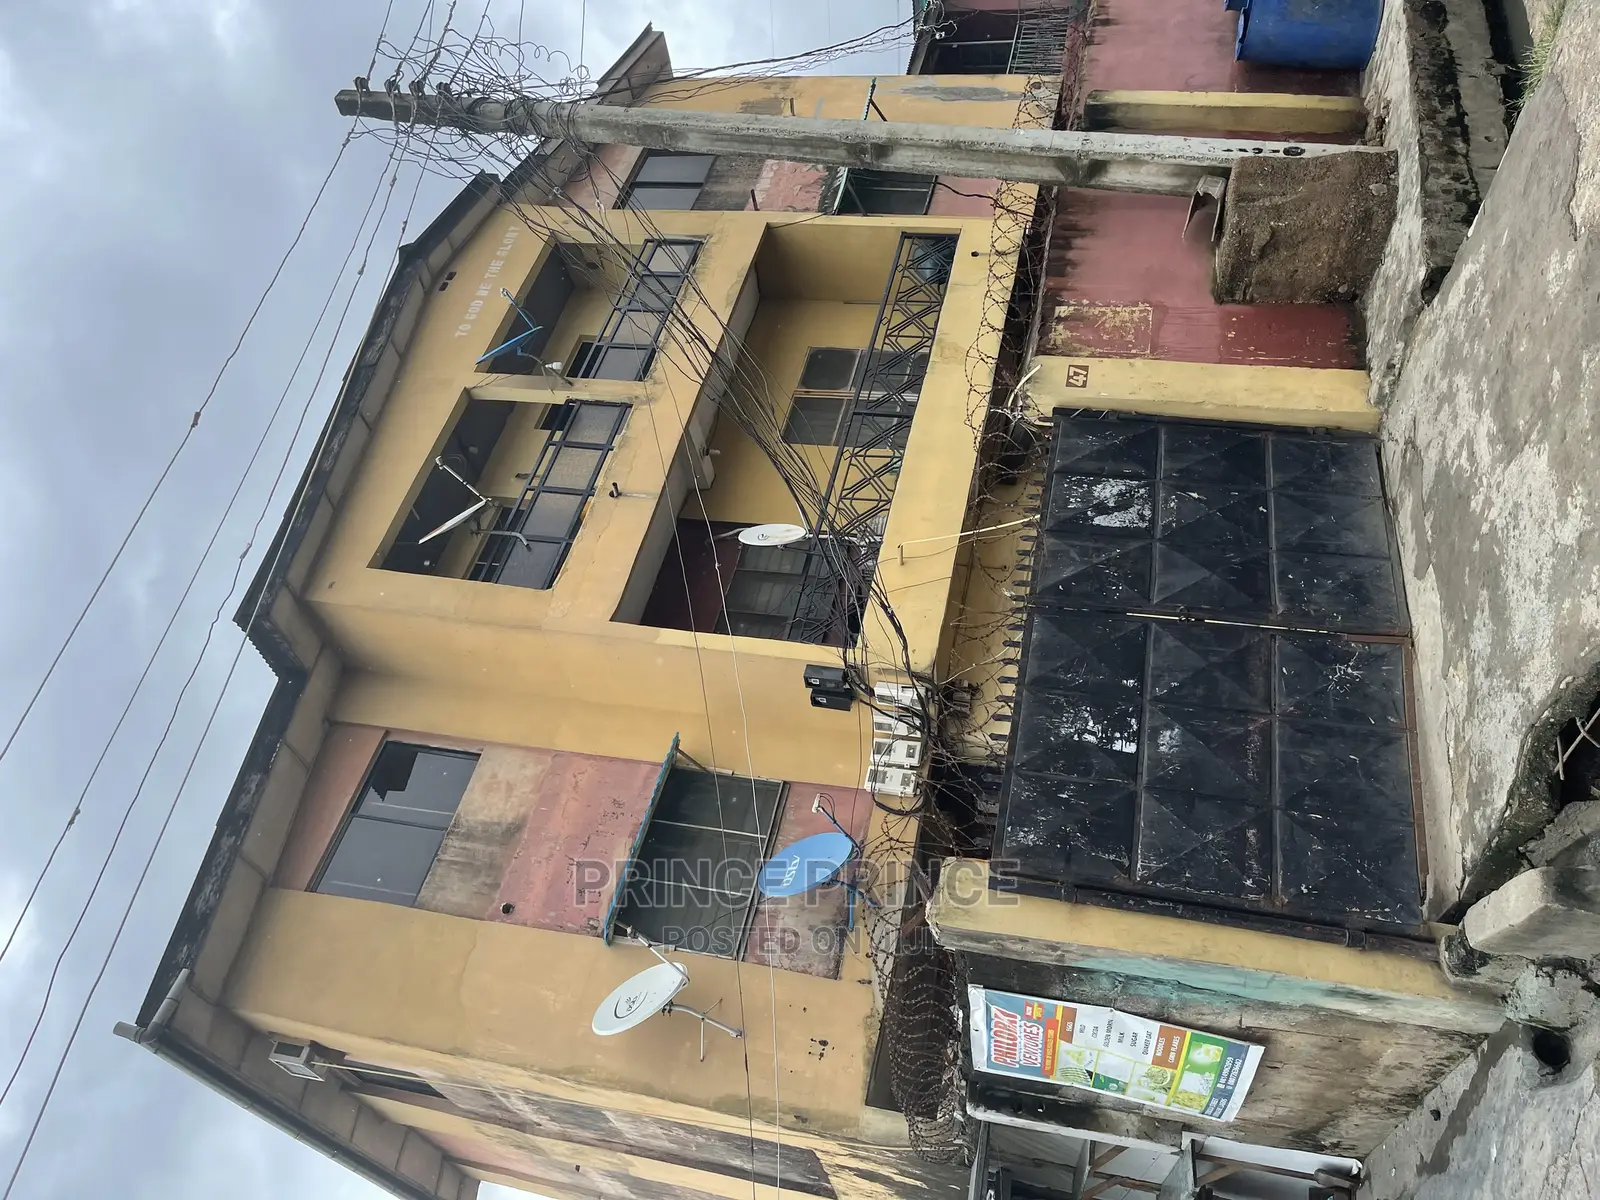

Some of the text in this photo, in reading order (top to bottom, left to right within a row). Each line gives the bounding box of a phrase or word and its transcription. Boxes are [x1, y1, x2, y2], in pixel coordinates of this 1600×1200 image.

[454, 225, 522, 338] TO GOD BE THE GLORY
[1068, 366, 1087, 387] 47
[1022, 1021, 1041, 1066] VENTURES
[1117, 1031, 1125, 1044] MILK
[1129, 1031, 1139, 1048] SUGAR
[1141, 1030, 1153, 1056] QUAKER OAT
[1155, 1037, 1166, 1057] NOODLES
[1167, 1035, 1181, 1064] CORN FLAKES
